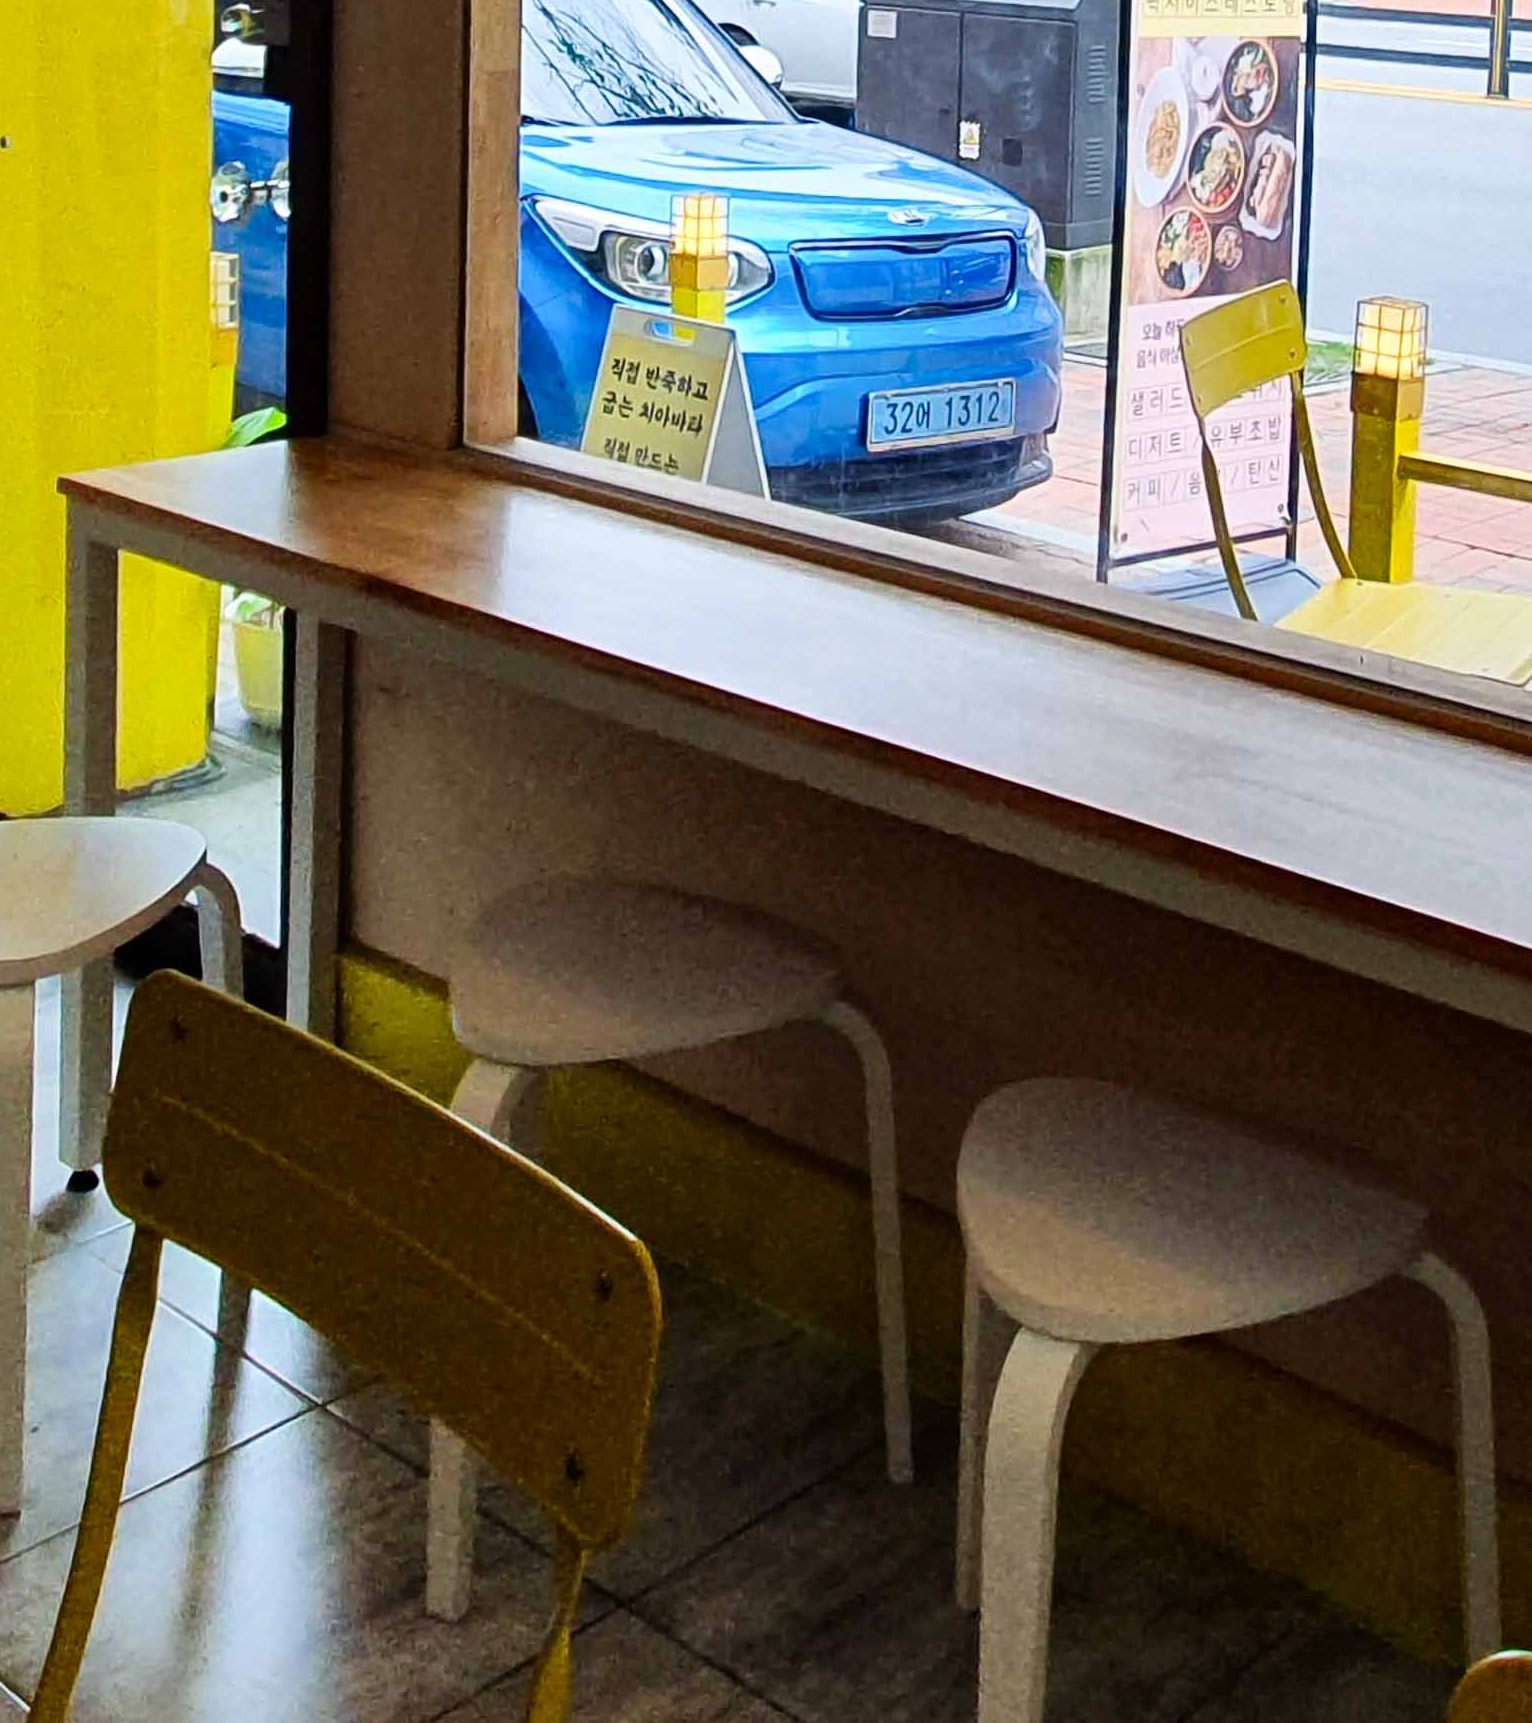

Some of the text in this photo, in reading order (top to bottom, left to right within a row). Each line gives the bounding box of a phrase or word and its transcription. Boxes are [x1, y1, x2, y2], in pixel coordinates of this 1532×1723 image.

[611, 358, 709, 401] 직접 반죽하고
[602, 391, 704, 438] 굽는 치아바타
[884, 391, 1000, 436] 32어 1312
[1130, 387, 1184, 418] 샐러드
[604, 438, 680, 475] 직접 만드는
[1127, 416, 1283, 461] 디저트 유부초밥
